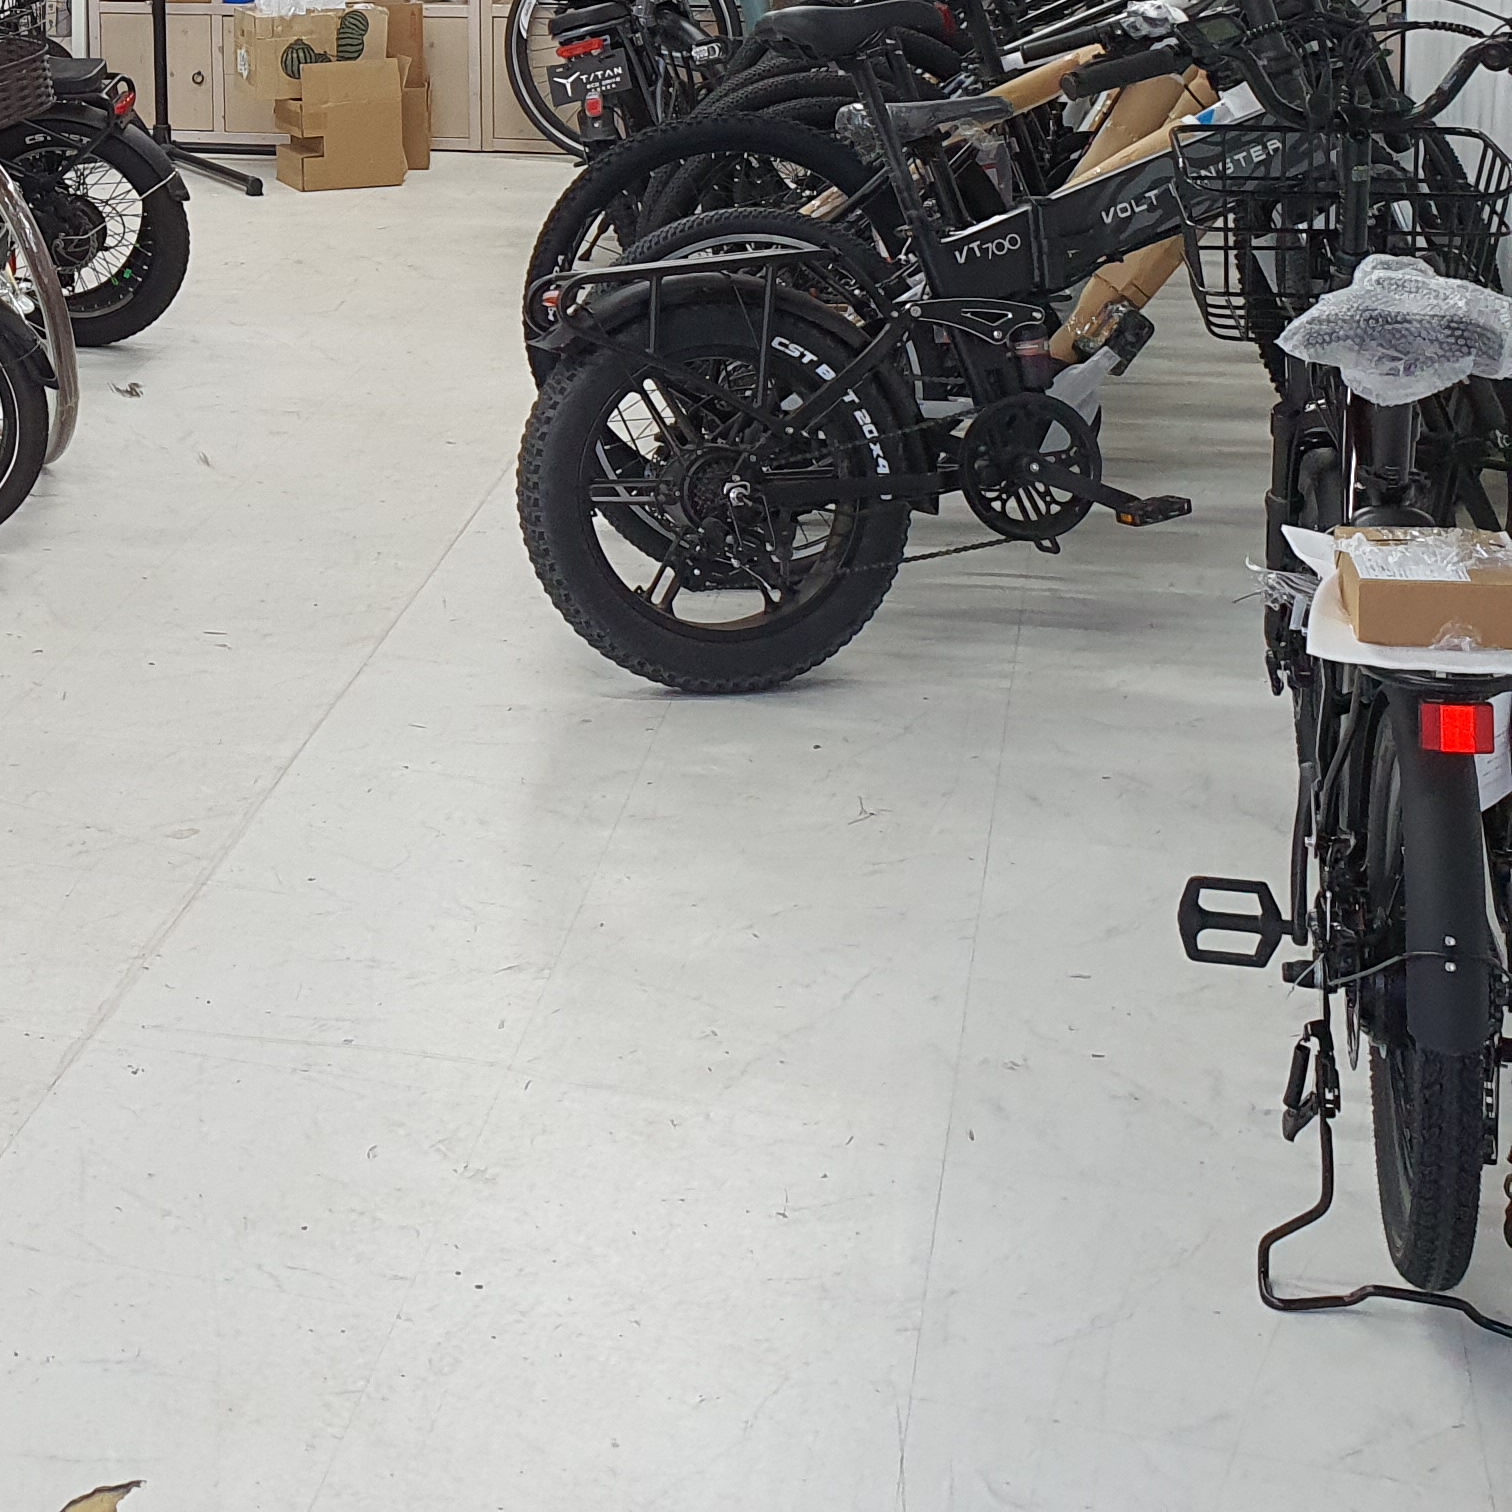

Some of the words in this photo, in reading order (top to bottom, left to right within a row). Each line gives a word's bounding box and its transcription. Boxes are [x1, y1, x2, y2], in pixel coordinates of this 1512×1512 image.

[1101, 189, 1160, 224] VOLT
[953, 233, 1021, 264] VT700
[770, 336, 819, 364] CST
